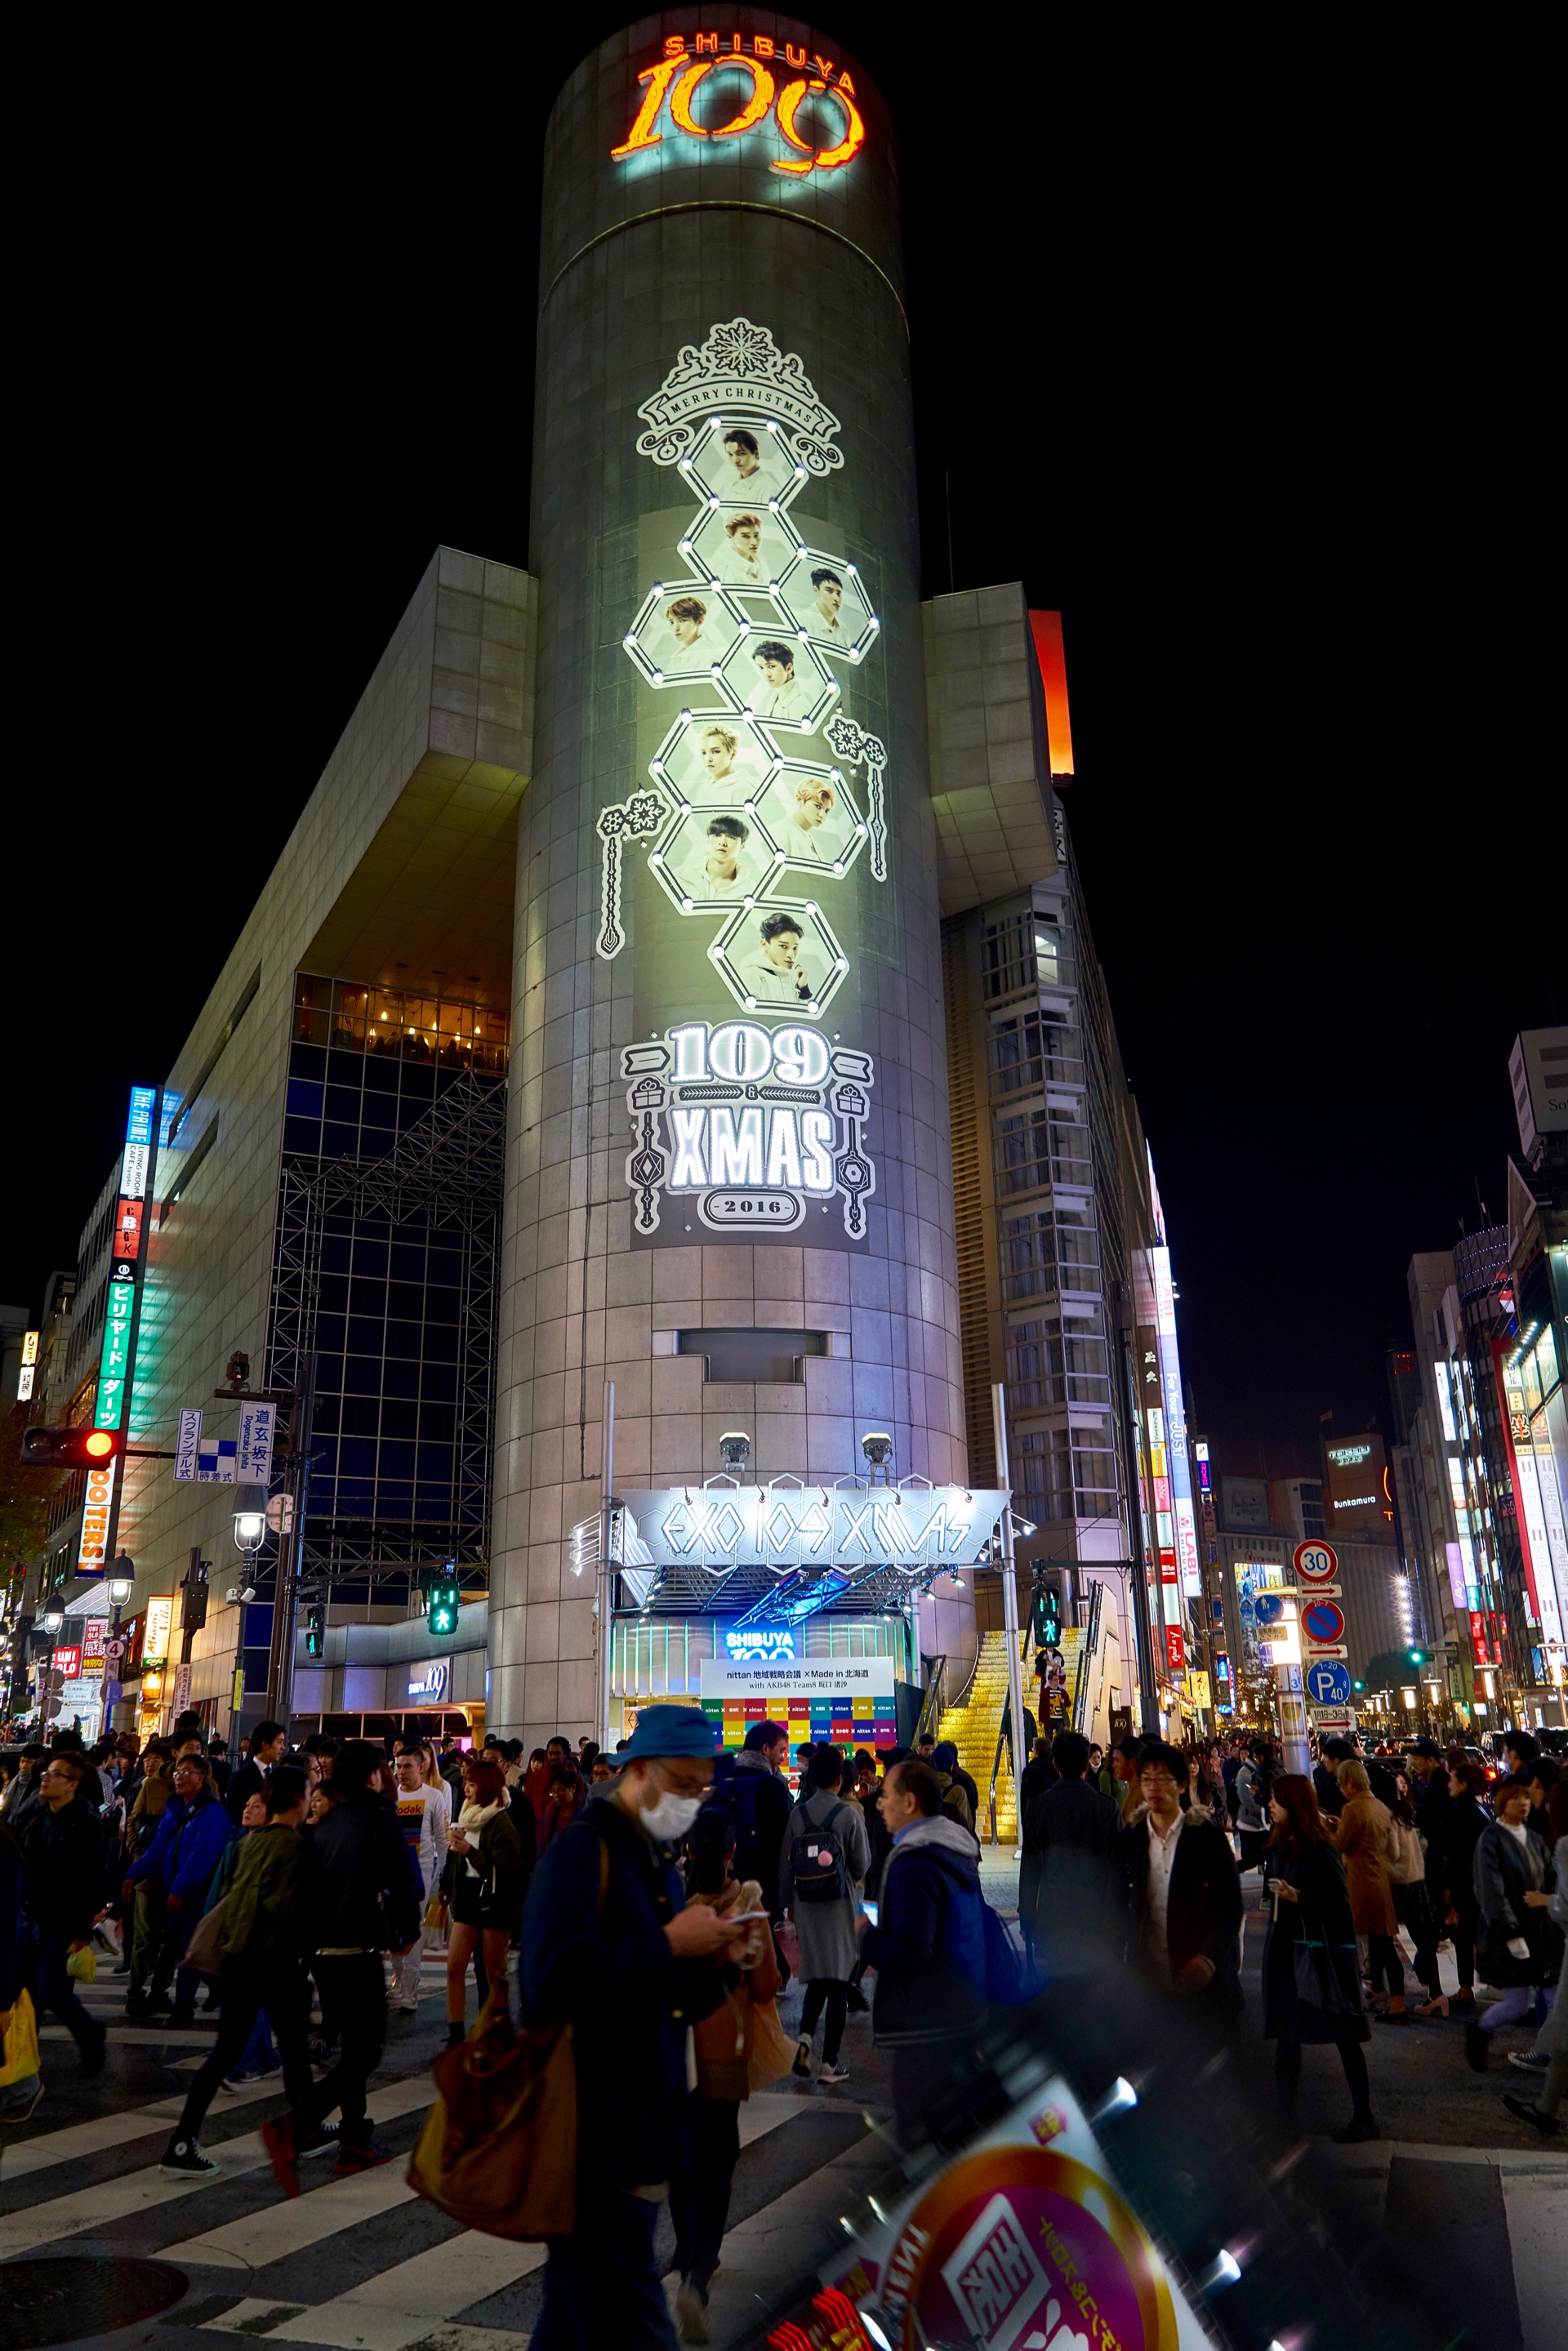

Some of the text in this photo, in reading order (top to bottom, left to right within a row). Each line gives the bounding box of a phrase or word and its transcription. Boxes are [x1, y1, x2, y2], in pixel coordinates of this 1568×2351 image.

[663, 32, 857, 99] SHIBUYA
[611, 53, 866, 176] 109
[670, 387, 813, 423] MERRY CHRISTMAS
[669, 1021, 831, 1087] 109
[130, 1091, 152, 1142] THE PRIME
[128, 1145, 136, 1164] CAFE
[670, 1106, 835, 1191] XMAS
[133, 1146, 145, 1194] LIVING ROOM
[100, 1285, 131, 1427] ビリヤード・ダーツ
[180, 1412, 196, 1478] スクランブル式
[243, 1415, 253, 1451] Dogenzaka
[252, 1409, 270, 1477] 道玄坂下
[1169, 1422, 1187, 1459] JUST
[199, 1472, 232, 1482] 時差式
[81, 1462, 111, 1560] OOTERS
[1334, 1495, 1376, 1508] Bunkamura
[662, 1503, 972, 1553] EXO 109 XMAS
[1185, 1532, 1197, 1575] LABI
[1304, 1552, 1327, 1570] 30
[57, 1651, 76, 1662] UNI
[109, 1642, 119, 1654] 4
[726, 1632, 794, 1647] SHIBUYA
[425, 1665, 444, 1701] 109
[727, 1671, 751, 1680] nittan
[753, 1669, 801, 1679] 地域戦略会議
[835, 1669, 844, 1678] in
[845, 1669, 869, 1678] 北海道
[1318, 1661, 1338, 1670] 7-20
[749, 1681, 764, 1689] with
[767, 1681, 791, 1689] AKB48
[793, 1681, 817, 1689] Team8
[1317, 1672, 1334, 1701] P
[1330, 1687, 1343, 1701] 40
[395, 1804, 422, 1815] odak
